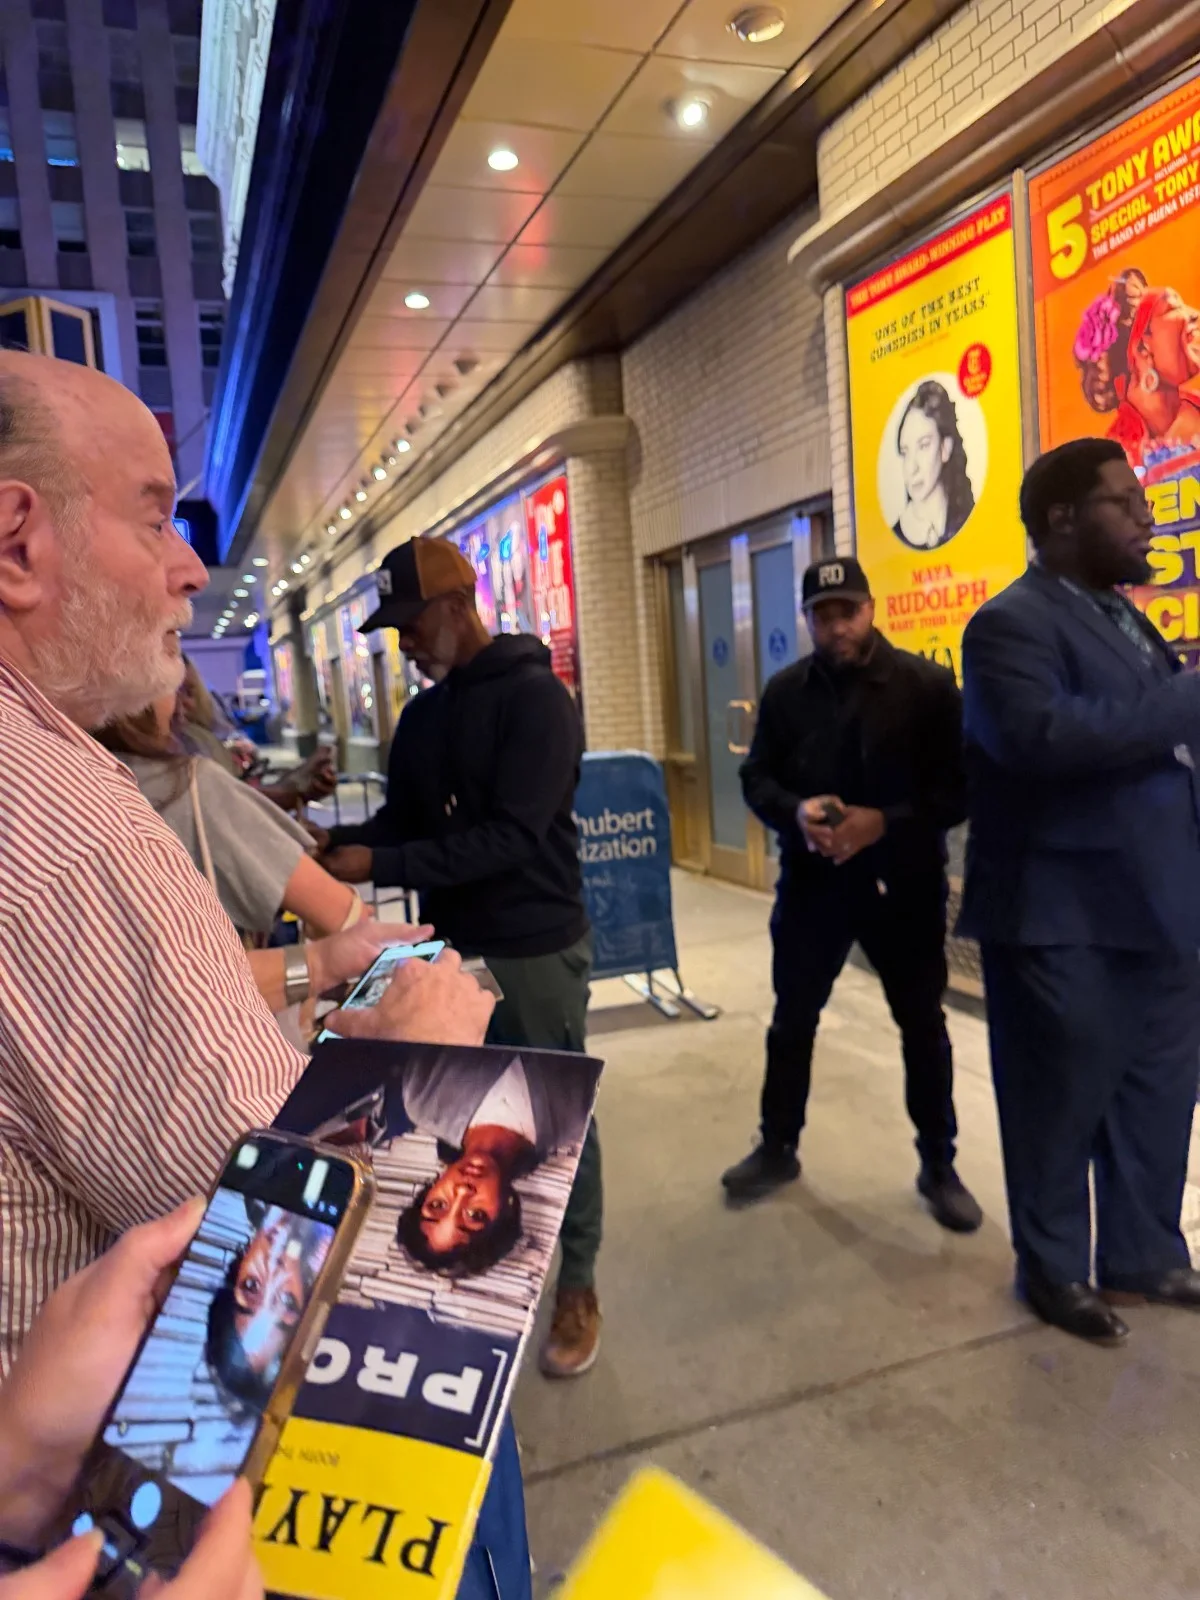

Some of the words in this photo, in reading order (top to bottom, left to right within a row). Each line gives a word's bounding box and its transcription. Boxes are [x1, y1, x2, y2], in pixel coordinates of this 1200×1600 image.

[1086, 147, 1148, 210] TONY
[1091, 194, 1152, 243] SPECIAL
[1154, 160, 1199, 202] TONY
[976, 206, 1006, 236] PLAY
[1047, 194, 1087, 279] 5
[1092, 241, 1109, 260] THE
[1133, 217, 1146, 235] OF
[949, 275, 981, 302] BEST
[929, 318, 942, 335] IN
[911, 563, 953, 585] MAYA
[886, 578, 988, 618] RUDOLPH
[576, 834, 657, 864] ization
